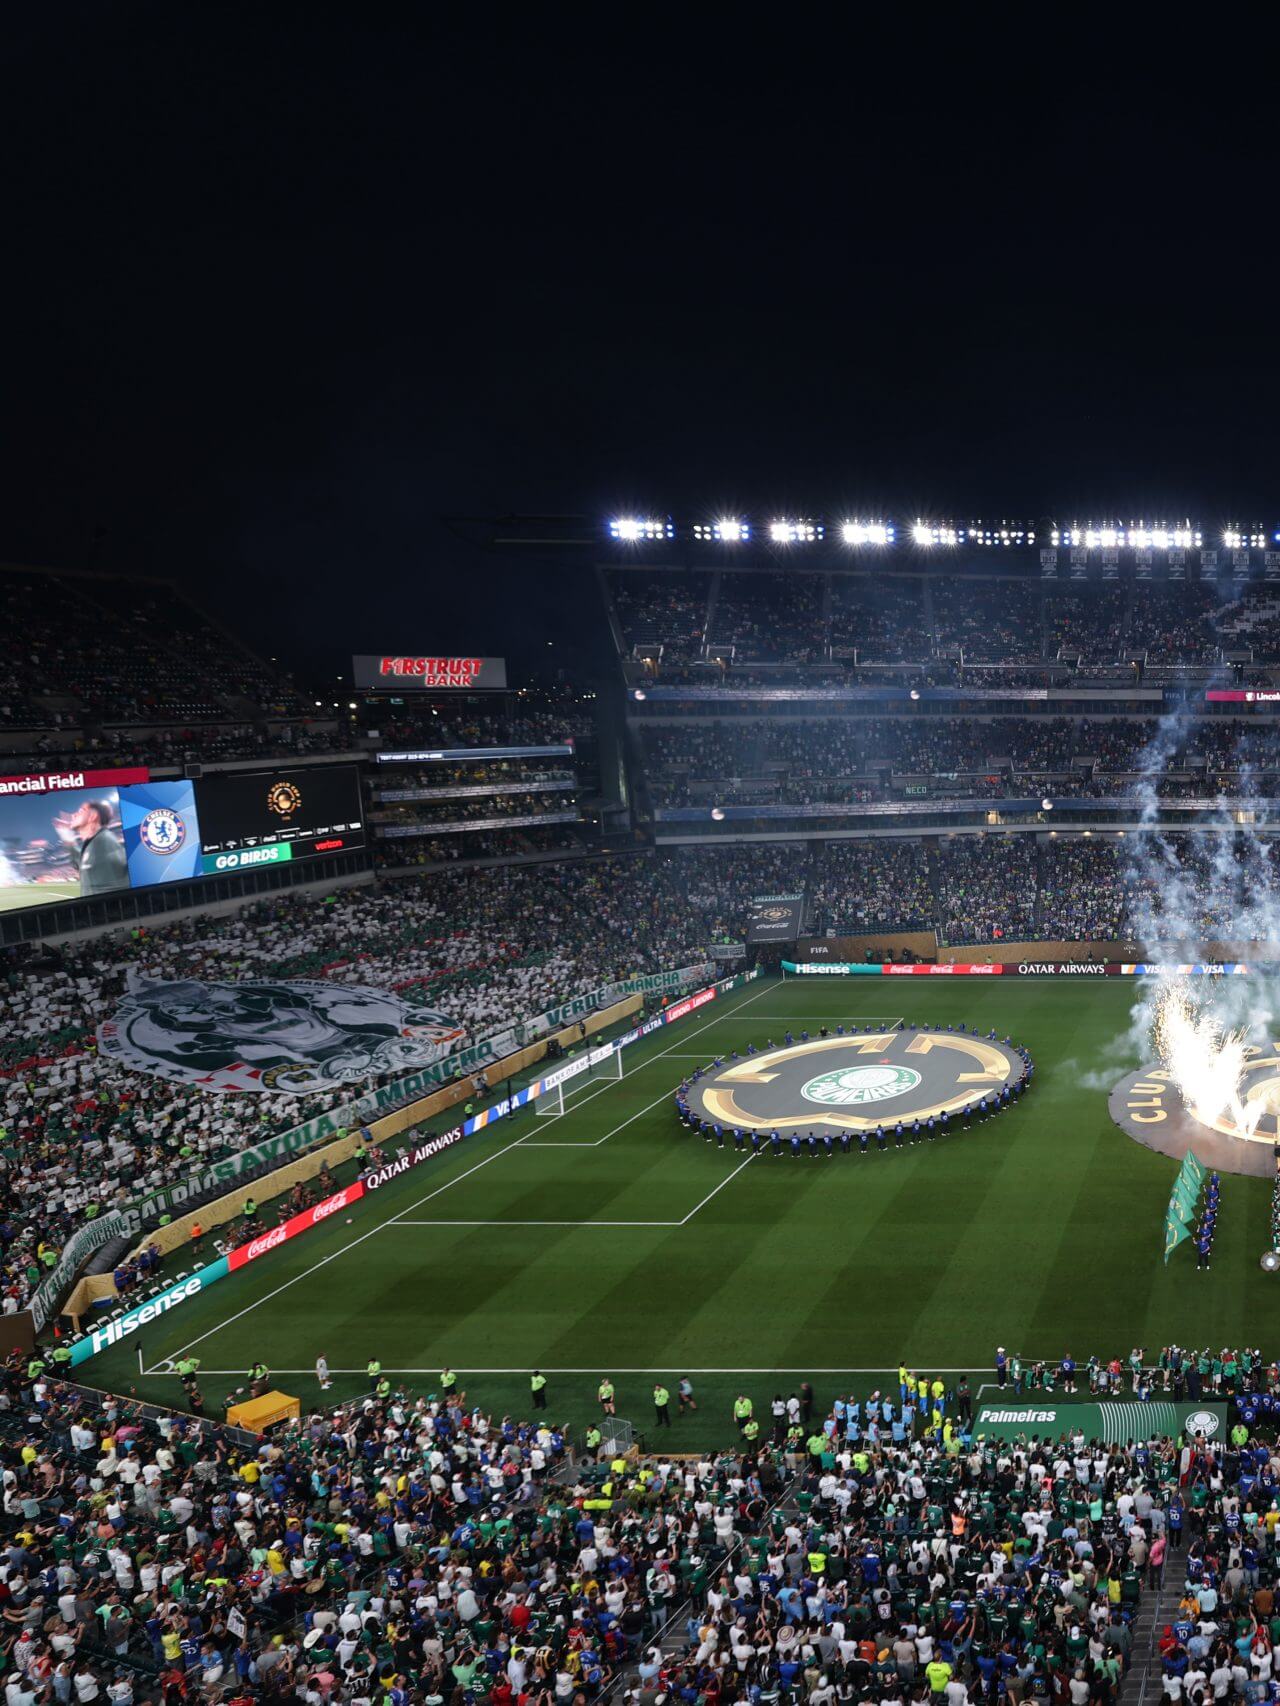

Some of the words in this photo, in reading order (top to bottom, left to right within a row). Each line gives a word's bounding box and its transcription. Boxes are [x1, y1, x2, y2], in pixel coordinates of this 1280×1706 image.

[425, 675, 473, 687] BANK
[48, 773, 85, 789] Field
[315, 839, 343, 851] verizon
[216, 855, 239, 869] GO
[240, 848, 279, 865] BIRDS
[810, 946, 828, 954] FIFA
[796, 963, 850, 974] Hisense
[889, 965, 914, 974] Coca-Cola
[929, 965, 954, 974] Coca-Cola
[969, 965, 994, 974] Coca-Cola
[1018, 964, 1055, 974] QATAR
[1059, 964, 1105, 974] AIRWAYS
[1202, 965, 1225, 974] VISA
[624, 972, 679, 993] MANCHA
[693, 991, 714, 1007] Lenovo
[669, 1003, 691, 1018] Lenovo
[643, 1018, 663, 1034] ULTRA
[809, 1081, 913, 1103] PALMEIRAS
[212, 1114, 336, 1182] SAVOIA
[366, 1156, 410, 1189] QATAR
[413, 1127, 462, 1164] AIRWAYS
[312, 1190, 349, 1222] Coca-Cola
[247, 1224, 288, 1259] Coca-Cola
[91, 1276, 203, 1355] Hisense
[979, 1409, 1056, 1423] Palmeiras
[1179, 1630, 1188, 1640] 10
